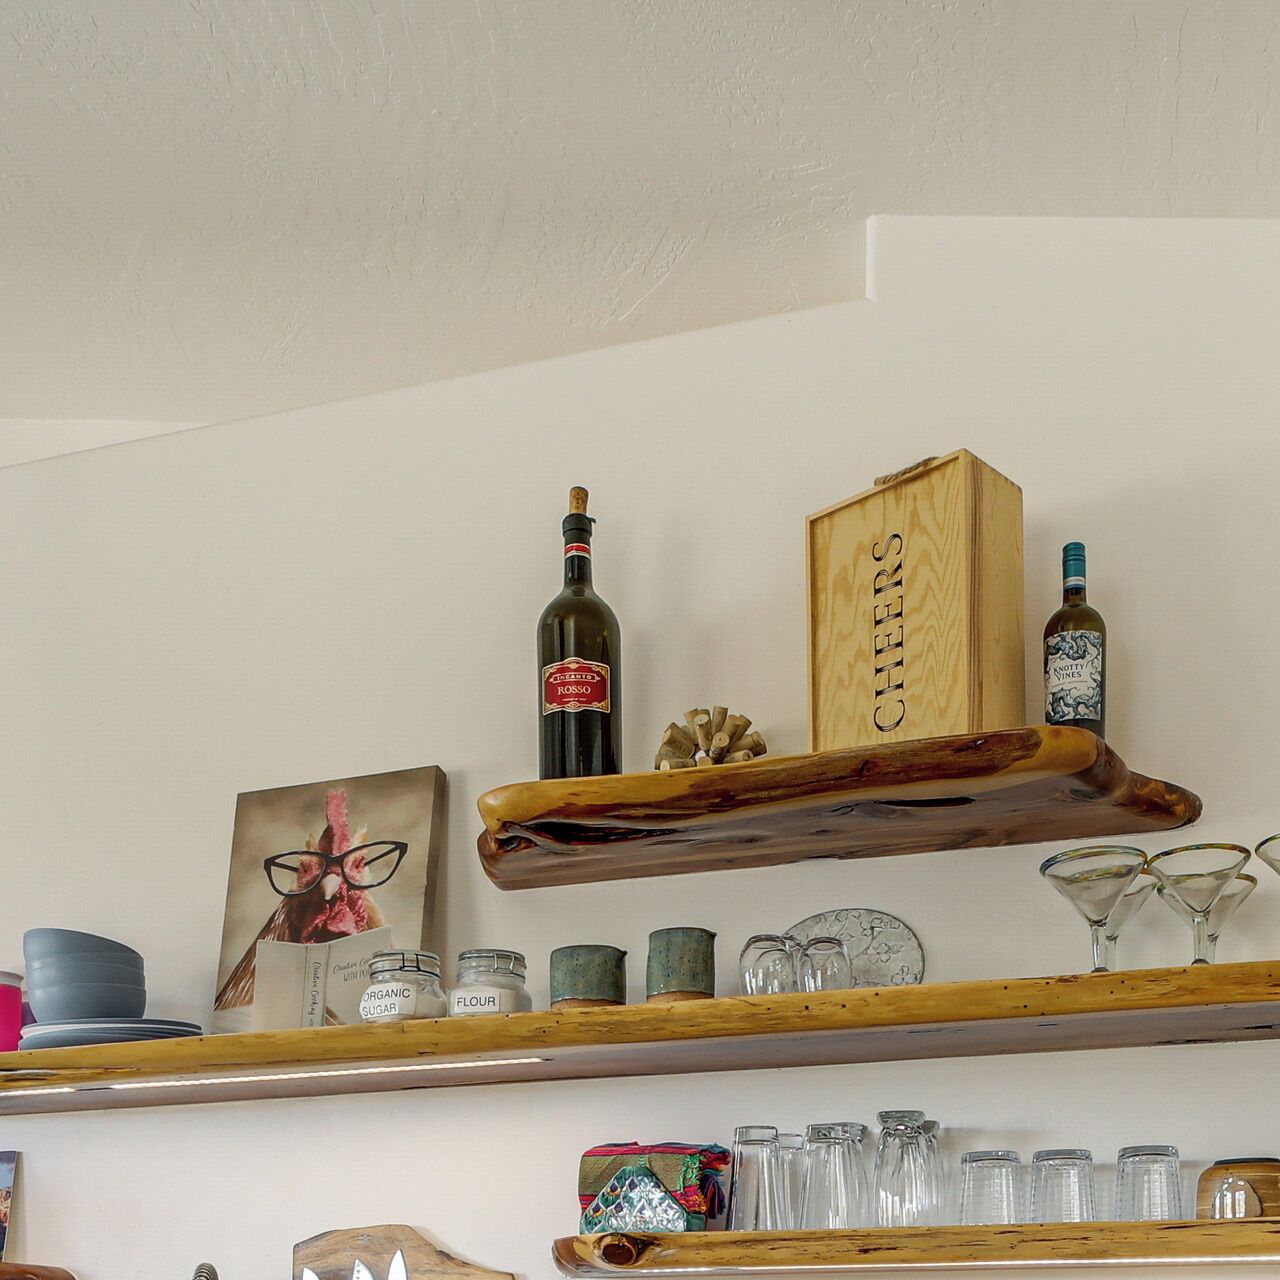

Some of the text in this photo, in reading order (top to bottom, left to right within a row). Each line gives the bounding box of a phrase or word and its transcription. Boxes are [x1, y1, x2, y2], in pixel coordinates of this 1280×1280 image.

[872, 533, 905, 733] CHEERS
[1054, 663, 1085, 674] KNOTTY
[1054, 671, 1082, 681] VINES
[557, 685, 591, 695] ROSSO
[363, 988, 411, 1002] ORGANIC
[457, 996, 496, 1008] FLOUR
[362, 1003, 397, 1017] SUGAR
